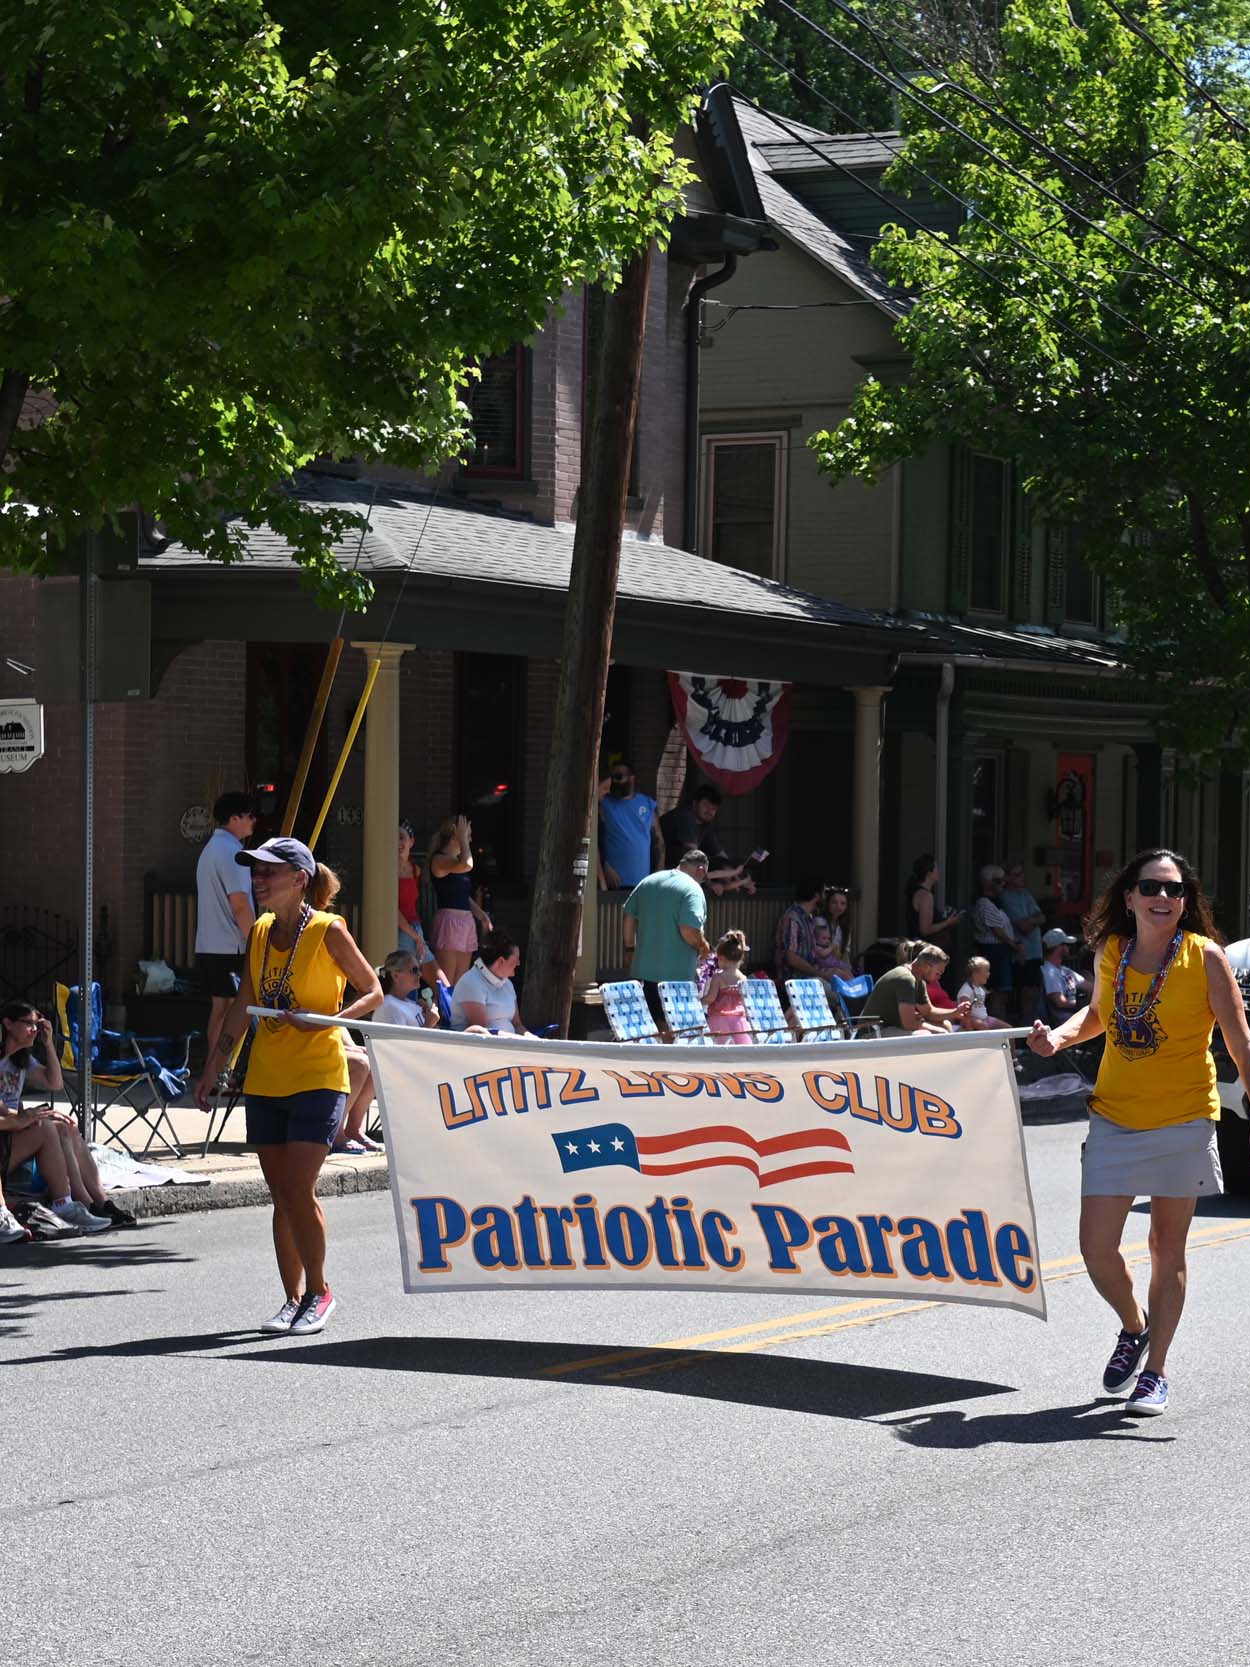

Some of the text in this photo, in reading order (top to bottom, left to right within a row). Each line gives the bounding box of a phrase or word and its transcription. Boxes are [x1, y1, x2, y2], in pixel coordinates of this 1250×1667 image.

[0, 753, 28, 761] USEUM
[437, 1065, 962, 1140] LITITZ LIONS CLUB
[408, 1192, 1037, 1294] Patriotic Parade
